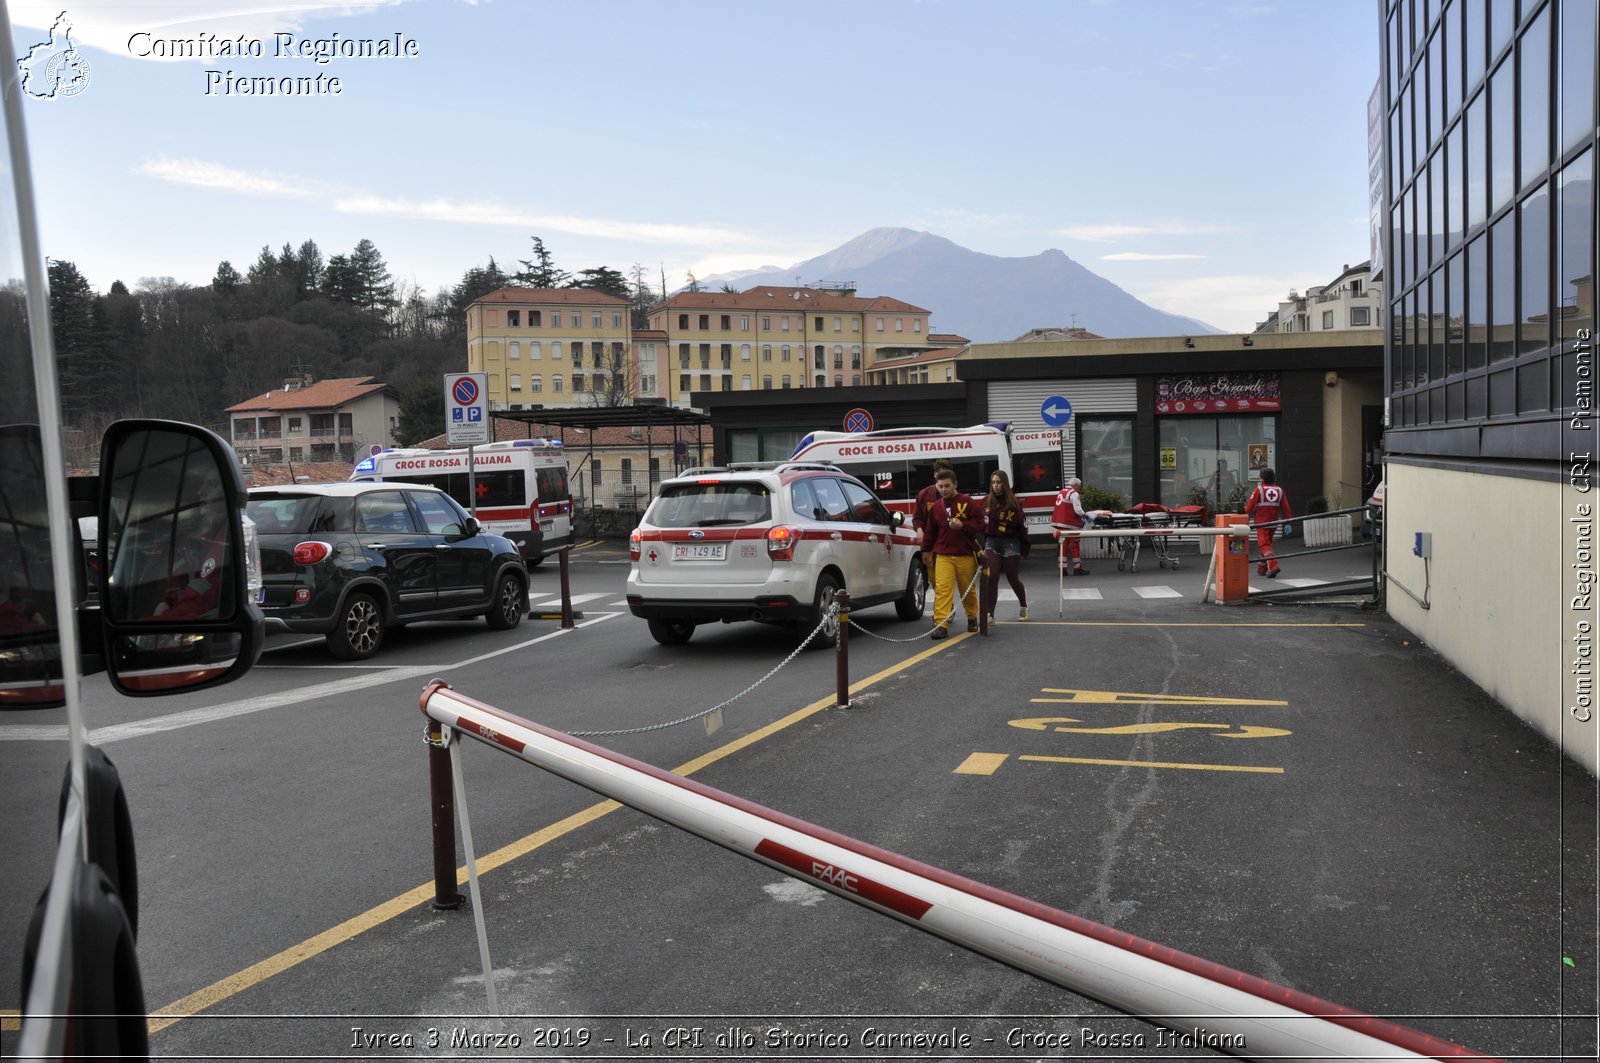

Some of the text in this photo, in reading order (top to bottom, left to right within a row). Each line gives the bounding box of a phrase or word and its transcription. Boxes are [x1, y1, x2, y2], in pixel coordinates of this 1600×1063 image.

[1174, 377, 1264, 395] Bar Girardi
[470, 408, 479, 421] P
[1015, 433, 1039, 441] CROCE
[838, 440, 973, 456] CROCE ROSSA ITALIANA
[395, 455, 512, 470] CROCE ROSSA IALIANA
[877, 472, 892, 480] 118
[675, 545, 722, 557] CRI 149 AE
[479, 725, 498, 742] FAAC
[812, 861, 859, 892] FAAC
